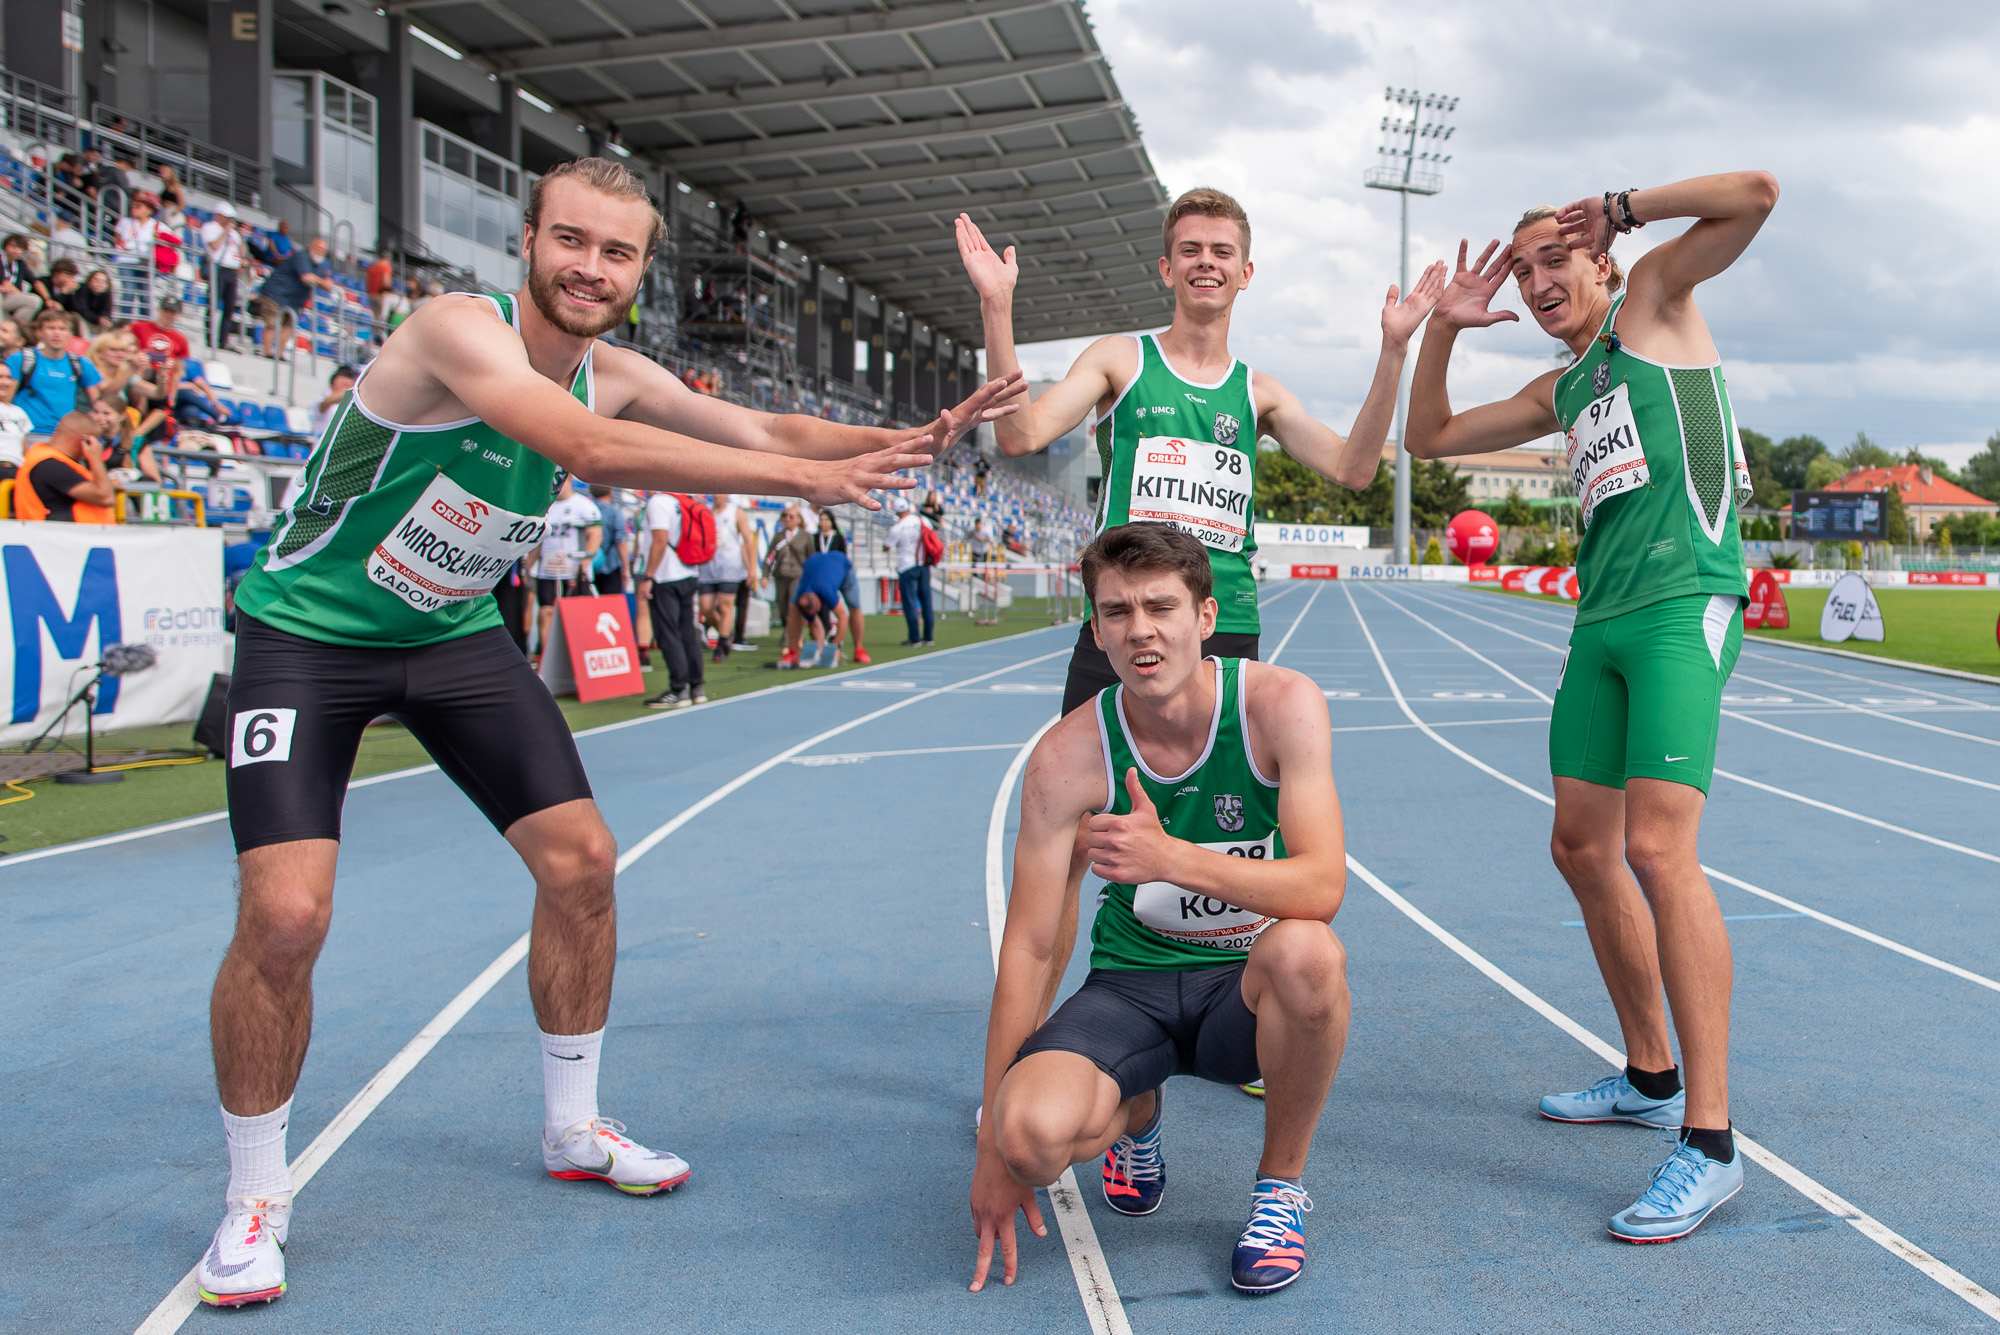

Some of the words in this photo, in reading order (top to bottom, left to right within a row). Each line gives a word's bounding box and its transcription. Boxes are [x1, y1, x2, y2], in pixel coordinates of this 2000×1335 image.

[232, 13, 257, 40] E
[1152, 406, 1175, 415] UMCS
[1590, 394, 1615, 427] 97
[483, 449, 513, 468] UMCS
[1150, 454, 1184, 464] ORLEN
[1215, 450, 1242, 475] 98
[1137, 475, 1247, 516] KITLIŃSKI
[1596, 477, 1625, 499] 2022
[435, 502, 478, 532] ORLEN
[1154, 512, 1208, 525] MISTRZOSTWA
[1210, 521, 1231, 531] POLSKI
[500, 520, 546, 543] 101
[1198, 529, 1226, 545] 2022
[1279, 527, 1345, 543] RADOM
[378, 548, 400, 570] PZLA
[400, 567, 460, 595] MISTRZOSTWA
[1351, 566, 1408, 578] RADOM
[1815, 571, 1842, 582] RAD
[373, 565, 440, 609] RADOM
[588, 655, 626, 672] ORLEN
[244, 713, 278, 757] 6
